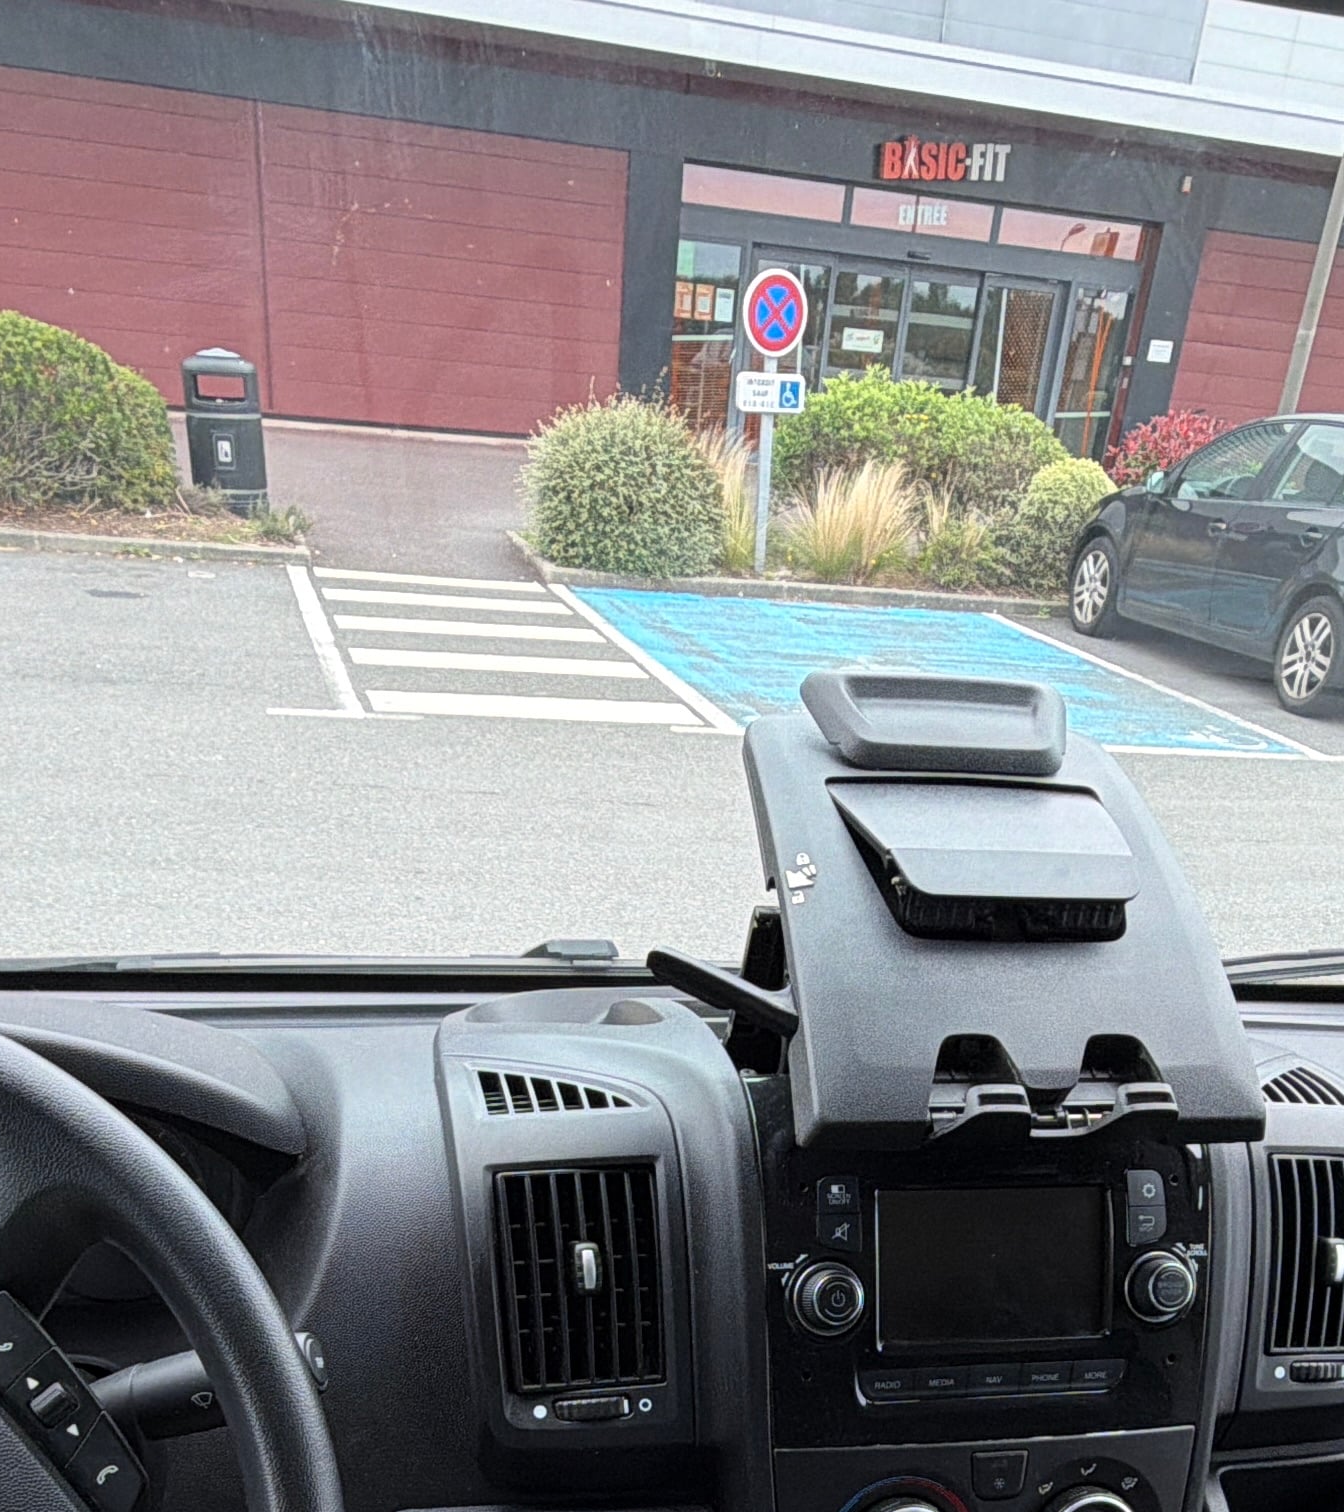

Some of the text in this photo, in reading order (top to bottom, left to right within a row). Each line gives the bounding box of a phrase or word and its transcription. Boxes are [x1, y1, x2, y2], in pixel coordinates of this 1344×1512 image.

[881, 135, 1011, 182] BASIC-FIT
[898, 204, 947, 225] ENTRÉE
[767, 1262, 794, 1270] VOLUME
[985, 1375, 1003, 1384] NAV
[1031, 1373, 1060, 1382] PHONE
[1084, 1371, 1107, 1380] MORE
[874, 1380, 901, 1390] RADIO
[928, 1378, 955, 1387] MEDIA
